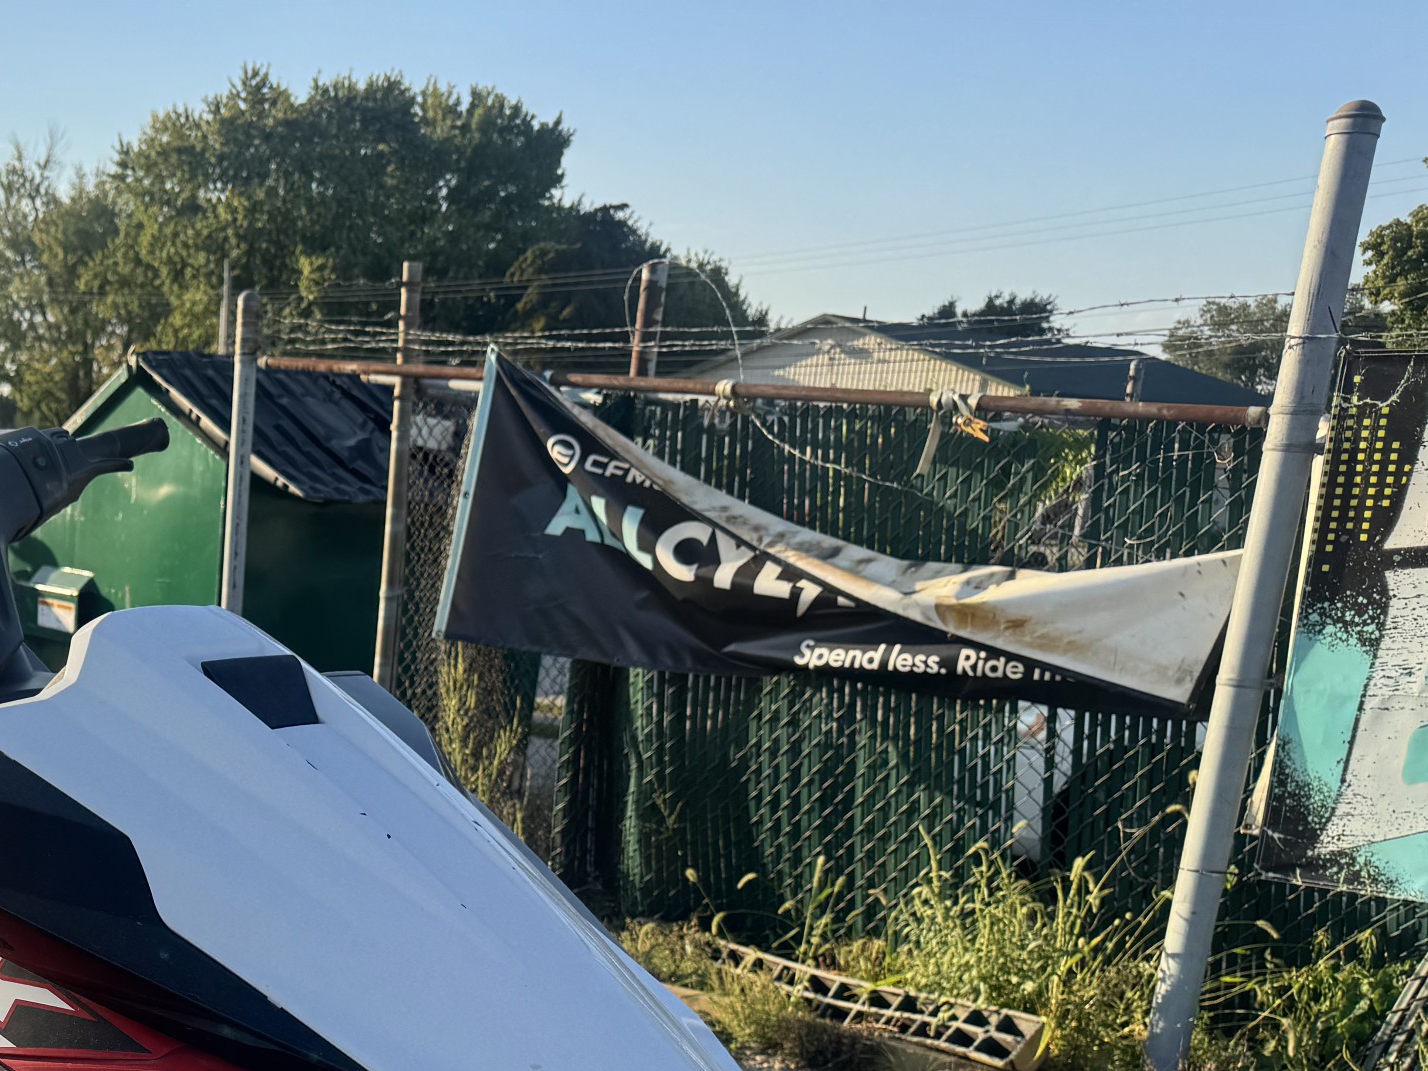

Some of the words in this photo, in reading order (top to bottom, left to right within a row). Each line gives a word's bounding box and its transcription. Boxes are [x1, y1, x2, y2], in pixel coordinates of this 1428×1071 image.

[793, 639, 887, 670] Spend
[887, 643, 947, 675] less.
[956, 648, 1025, 680] Ride
